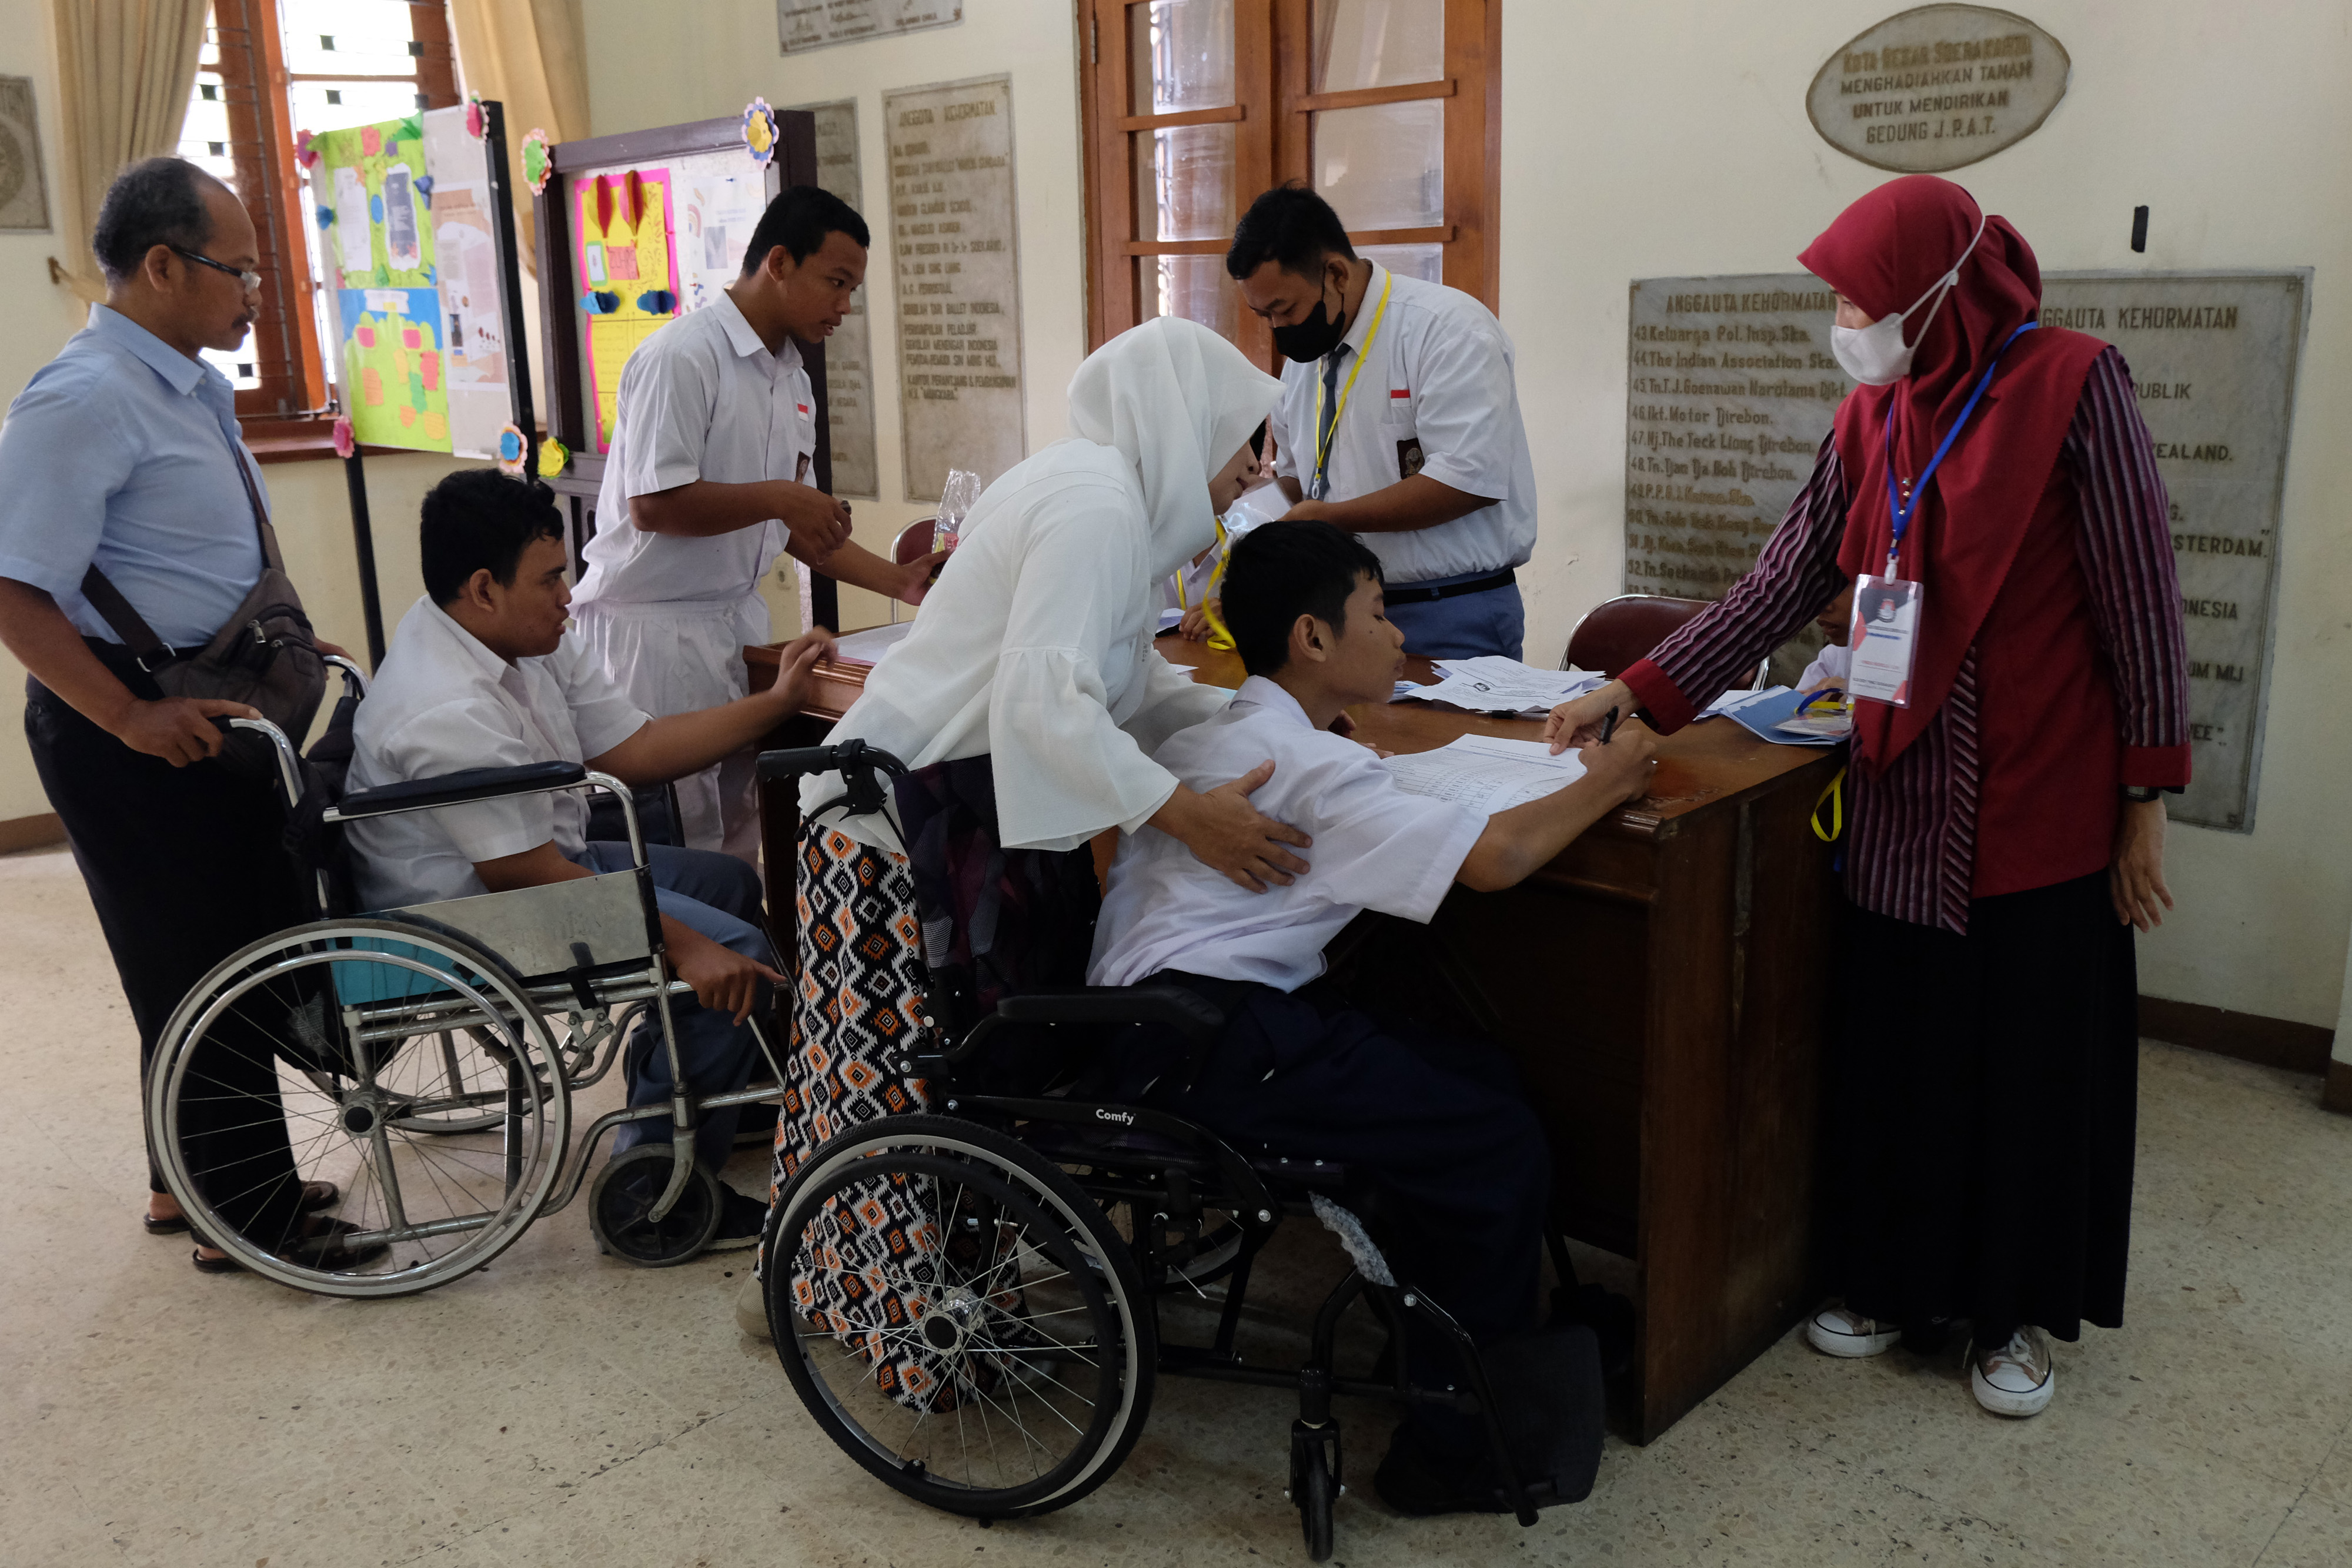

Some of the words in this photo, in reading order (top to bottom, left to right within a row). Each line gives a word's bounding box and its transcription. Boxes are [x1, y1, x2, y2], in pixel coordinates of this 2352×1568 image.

[1840, 68, 1973, 95] MENGHADIAHKAN
[1853, 101, 1903, 119] UNTUK
[1910, 91, 2010, 115] MENDIRIKAN
[1866, 122, 1928, 144] GEDUNG
[1666, 295, 1736, 313] ANGGAUTA
[1742, 292, 1836, 313] KEHORMATAN
[2039, 307, 2105, 329] GGAUTA
[2118, 306, 2239, 329] KEHORMATAN
[1676, 352, 1716, 368] Indian
[1721, 352, 1802, 369] Association
[2153, 443, 2233, 461] EALAND.
[1095, 1108, 1134, 1126] Comfy
